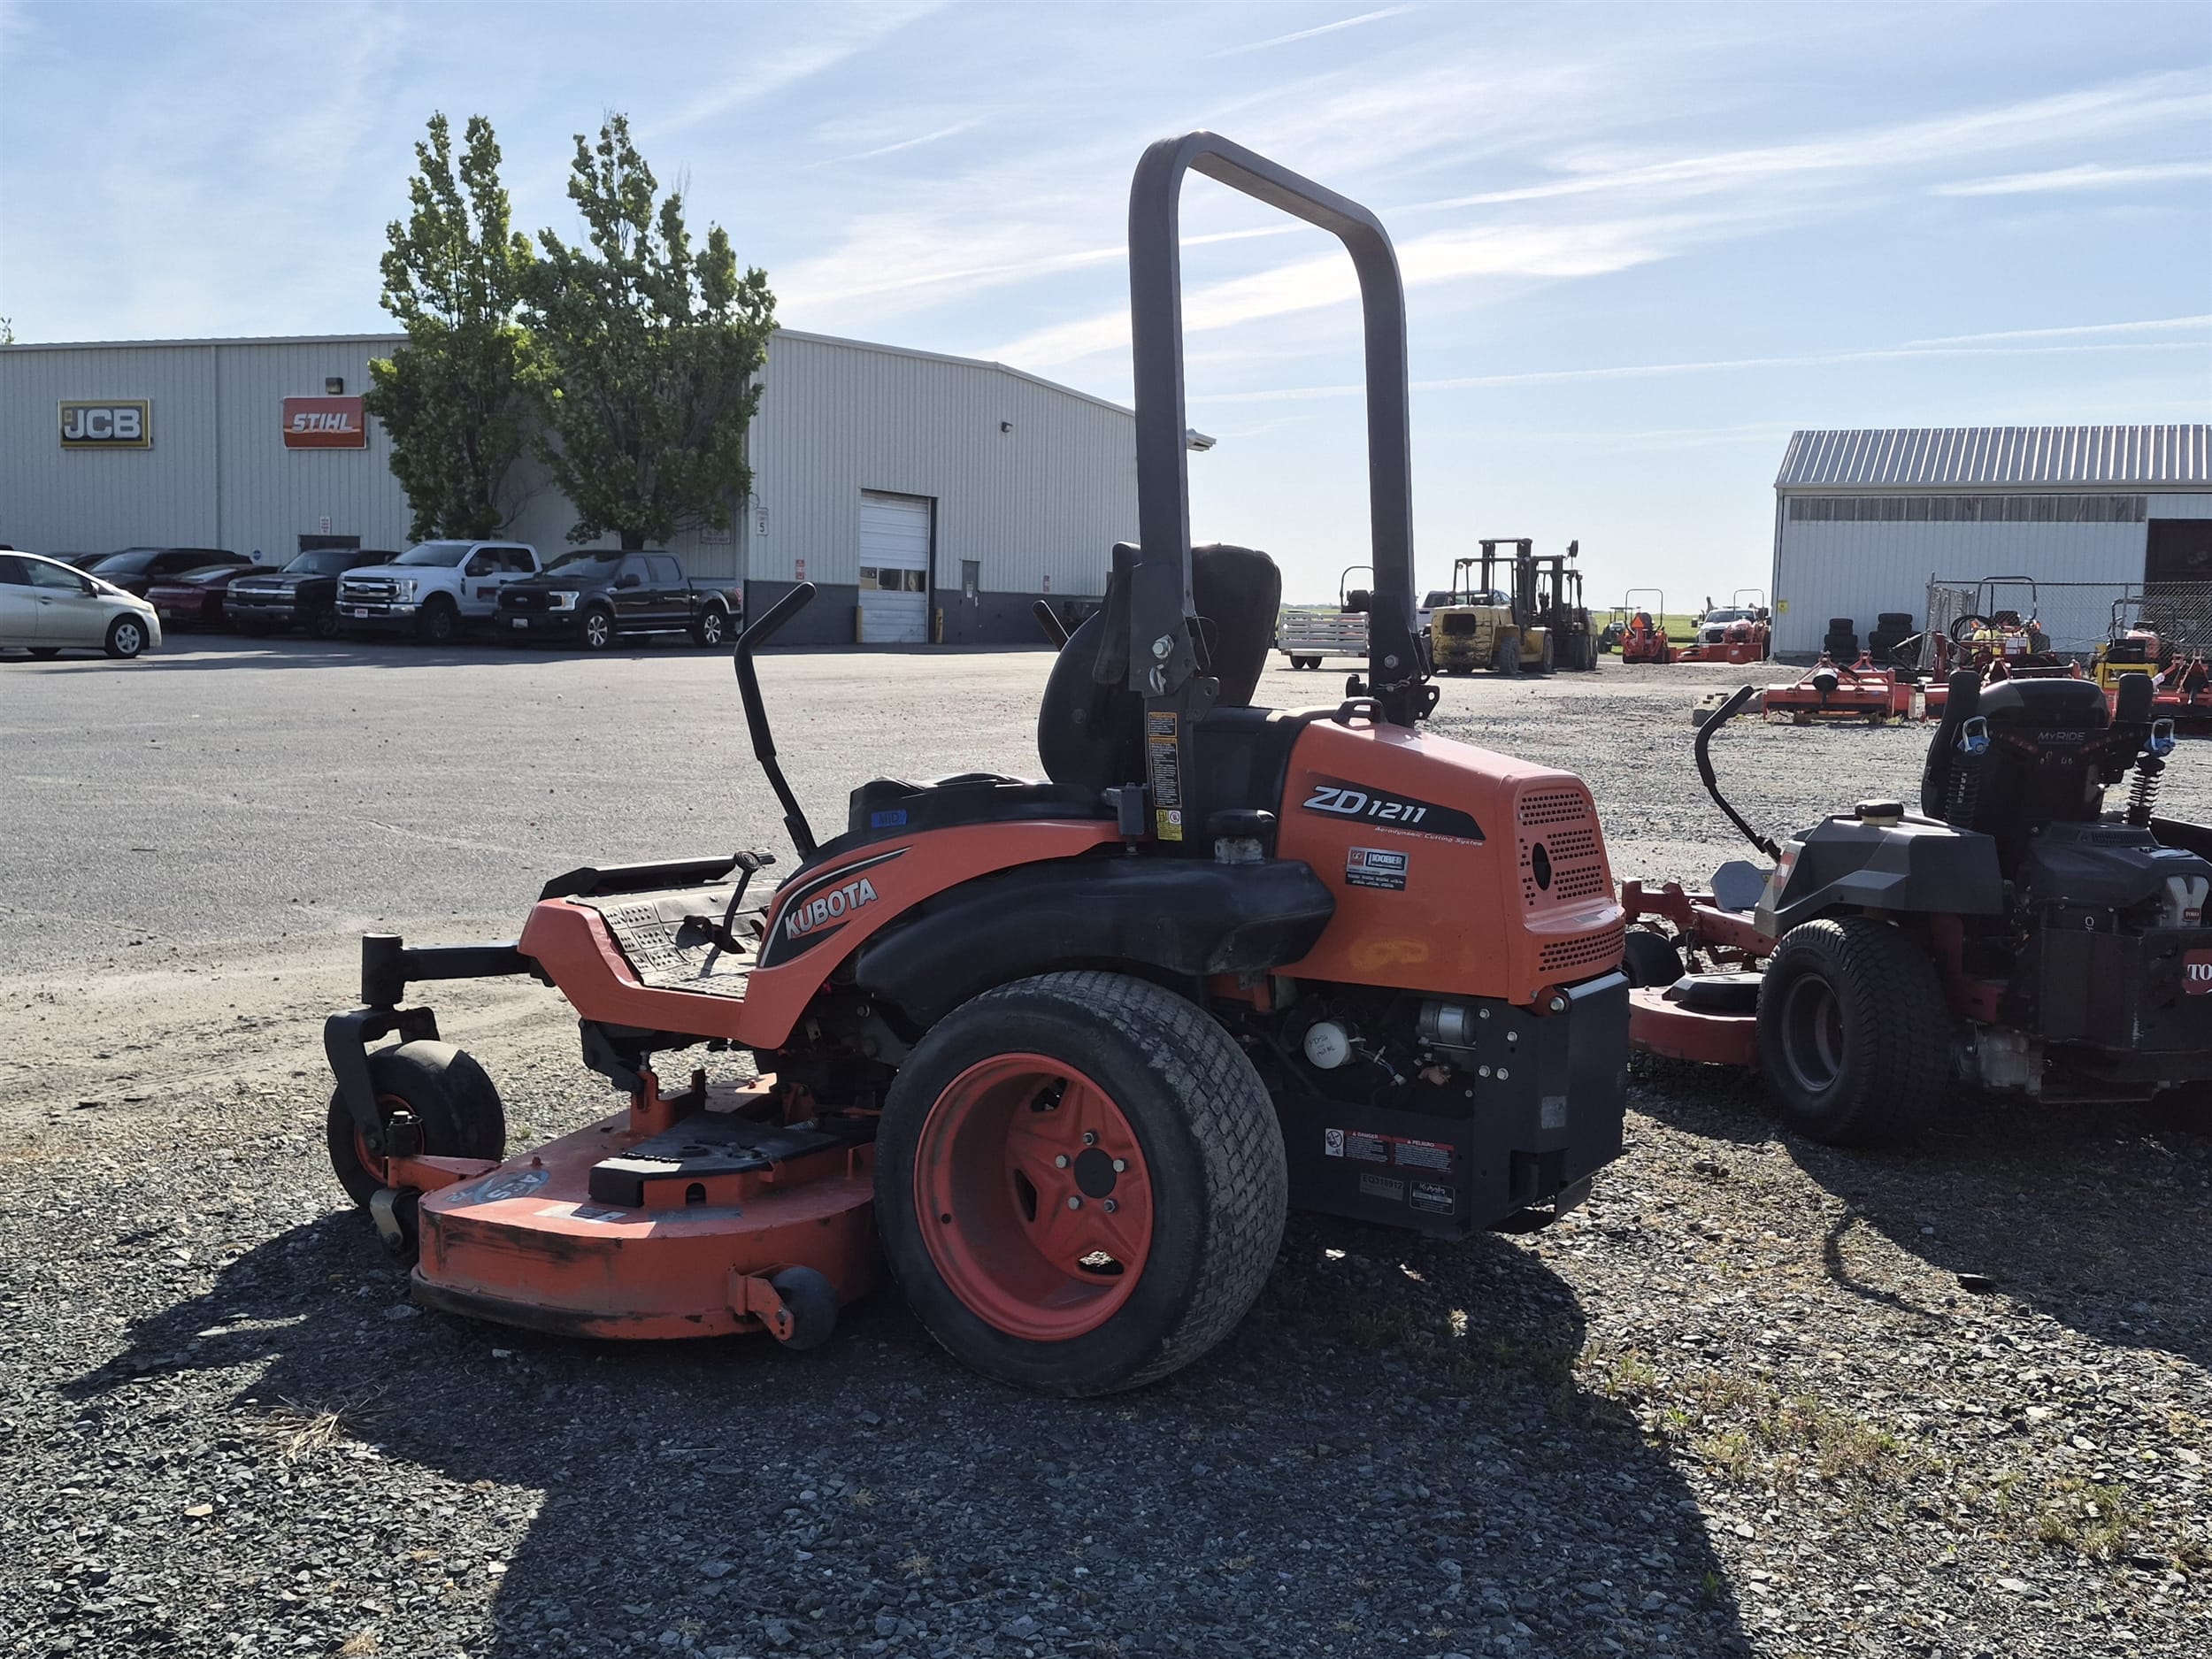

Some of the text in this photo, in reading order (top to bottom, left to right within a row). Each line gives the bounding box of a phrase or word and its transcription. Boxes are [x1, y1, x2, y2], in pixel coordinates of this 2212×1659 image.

[65, 410, 141, 439] JCB
[291, 413, 353, 433] STIHL
[759, 522, 765, 533] 5
[1374, 826, 1484, 847] Aerodynamic Cutting System
[785, 878, 879, 941] KUBOTA
